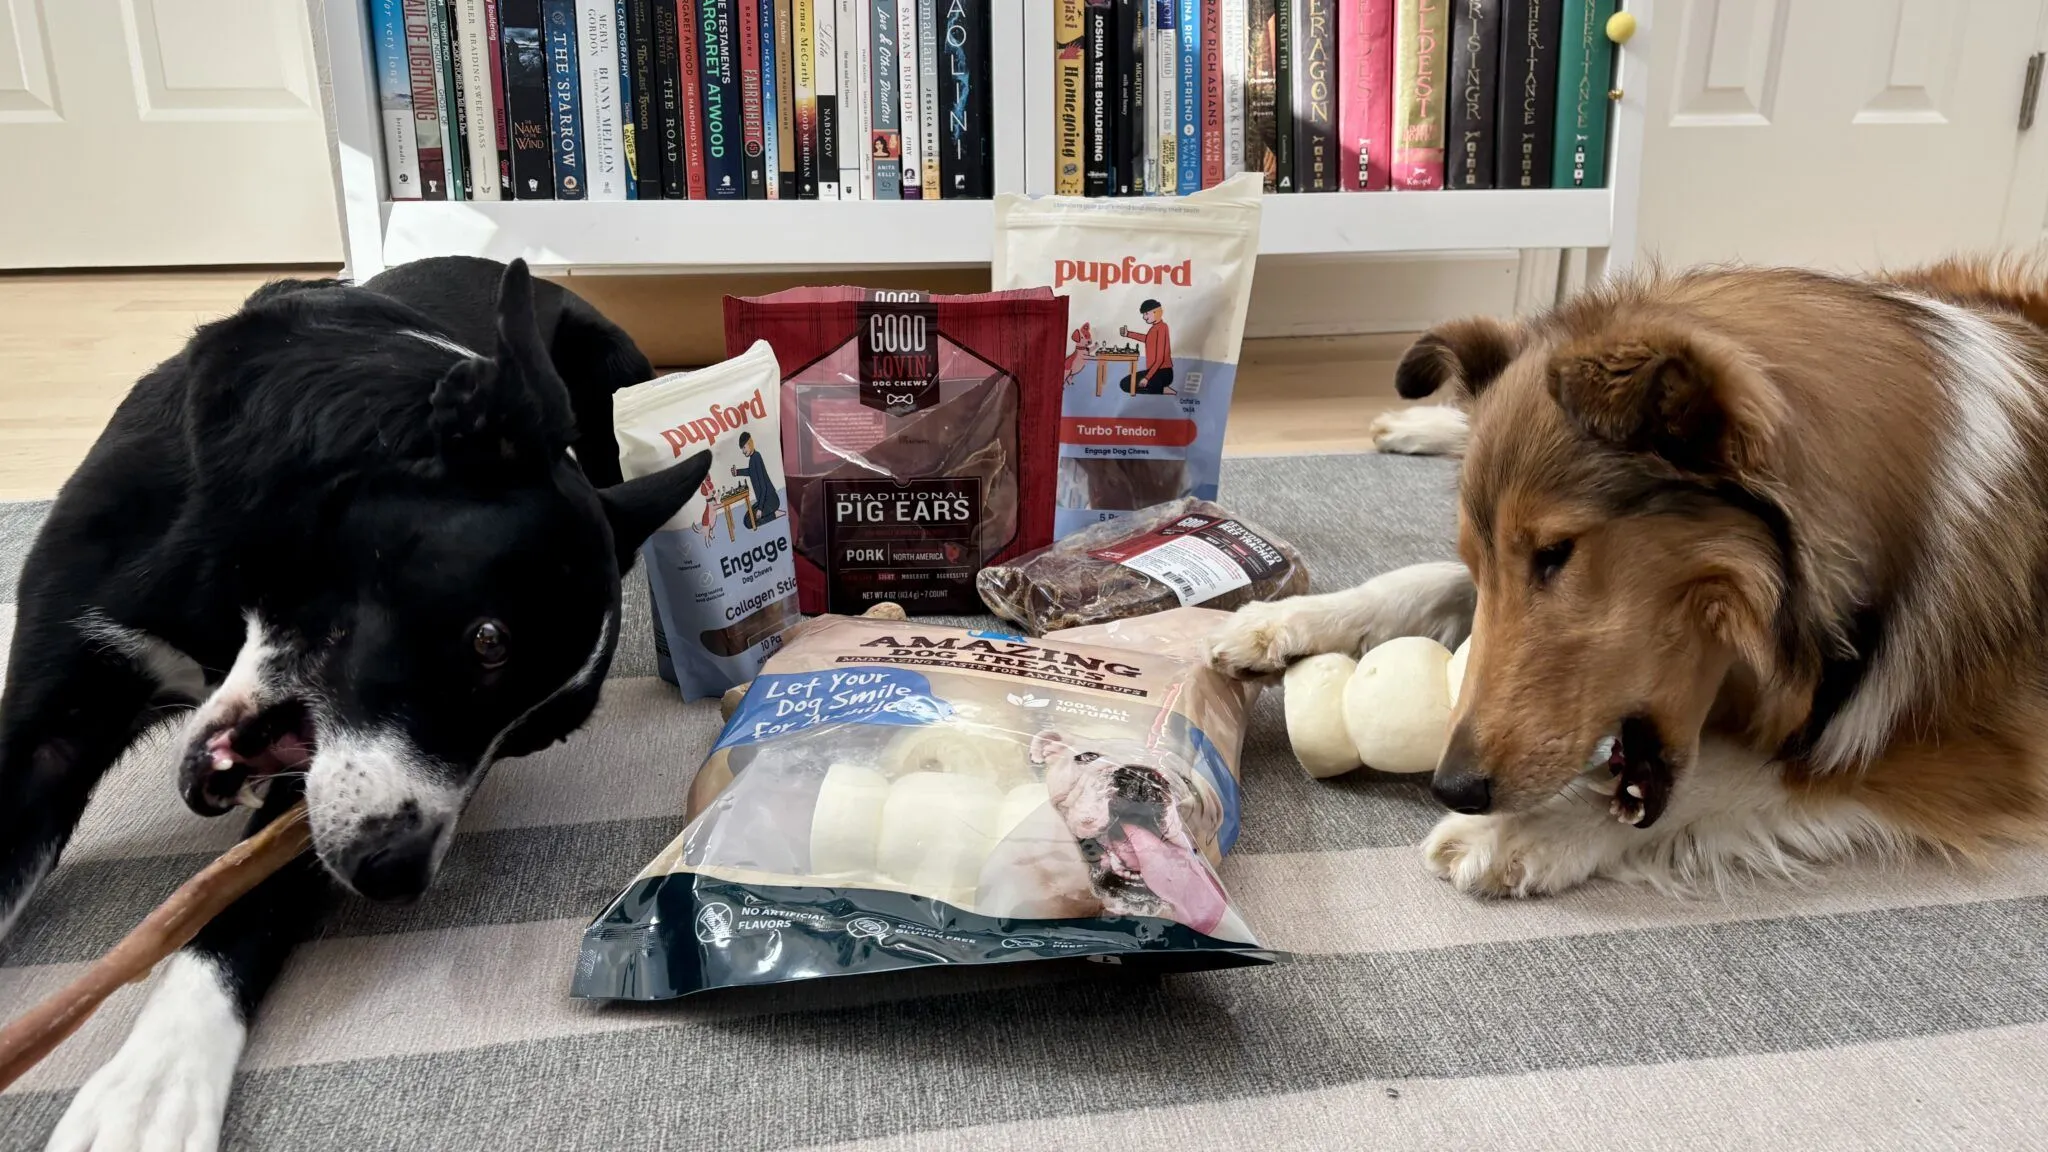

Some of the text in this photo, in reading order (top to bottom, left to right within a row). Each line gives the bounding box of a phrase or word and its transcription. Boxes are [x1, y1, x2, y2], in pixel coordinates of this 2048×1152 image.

[384, 22, 394, 50] very
[440, 20, 448, 45] TOMMY
[488, 4, 497, 40] Bouldering
[588, 8, 598, 57] GORDON
[600, 14, 608, 52] MERYL
[664, 12, 674, 60] CORMAC
[764, 33, 770, 44] OF
[819, 19, 833, 58] Lolita
[902, 8, 911, 59] SALMAN
[1095, 14, 1104, 59] JOSHUA
[554, 33, 568, 73] THE
[618, 8, 629, 78] CARTOGRAPHY
[637, 45, 647, 66] The
[684, 36, 693, 76] ATWOOD
[719, 13, 731, 84] TESTAMENTS
[1208, 40, 1217, 72] RICH
[387, 56, 399, 84] long
[408, 25, 437, 120] OF LIGHTNING
[434, 43, 443, 72] NGUYEN
[439, 88, 447, 112] GHOST
[638, 66, 648, 91] Last
[800, 37, 811, 89] McCarthy
[877, 6, 893, 124] Love & Other Disasters
[1095, 60, 1104, 88] TREE
[1184, 25, 1193, 121] RICH GIRLFRIEND
[470, 33, 485, 149] BRAIDING SWEETGRASS
[600, 67, 610, 110] BUNNY
[744, 69, 761, 138] FAHRENHEIT
[903, 66, 912, 122] RUSHDIE
[1208, 76, 1217, 126] ASIANS
[515, 122, 542, 134] NAME
[557, 81, 576, 168] SPARROW
[640, 92, 650, 130] Tycoon
[664, 78, 677, 162] THE ROAD
[688, 99, 697, 147] HANDMAID'S
[707, 83, 725, 158] ATWOOD
[1062, 66, 1079, 157] Homegoing
[1095, 91, 1104, 161] BOULDERING
[515, 138, 544, 150] WIND
[602, 118, 614, 173] MELLON
[823, 108, 833, 157] NABOKOV
[1204, 131, 1212, 161] KWAN
[803, 134, 811, 178] MERIDIAN
[1189, 138, 1197, 167] KEVIN
[1231, 140, 1240, 165] GUIN
[1055, 256, 1193, 290] pupford
[870, 314, 926, 353] GOOD
[872, 355, 932, 378] LOVIN'
[660, 388, 767, 459] pupford
[1077, 424, 1156, 437] Turbo Tendon
[836, 491, 969, 501] TRADITIONAL
[836, 499, 970, 522] PIG EARS
[1099, 513, 1105, 522] 5
[720, 536, 788, 579] Engage
[846, 549, 884, 562] PORK
[915, 552, 944, 560] AMERICA
[1217, 523, 1276, 566] BEEF TRACHEA
[1226, 520, 1283, 563] DEHYDRATED
[742, 566, 773, 584] Dog Chews
[725, 588, 776, 621] Collagen
[862, 591, 873, 600] NET
[874, 591, 884, 600] WT
[760, 640, 770, 651] 10
[859, 636, 1142, 678] AMAZING
[888, 648, 1106, 681] DOG TREATS
[765, 672, 891, 700] Let Your
[842, 656, 1142, 696] MMM-AZING TASTE FOR AMAZING PUPS
[775, 683, 912, 717] Dog Smile
[1055, 698, 1130, 717] 100% ALL
[1055, 705, 1129, 723] NATURAL
[752, 721, 797, 740] For
[738, 919, 792, 930] FLAVORS
[741, 907, 826, 921] NO ARTIFICIAL
[894, 928, 977, 944] GLUTEN FREE
